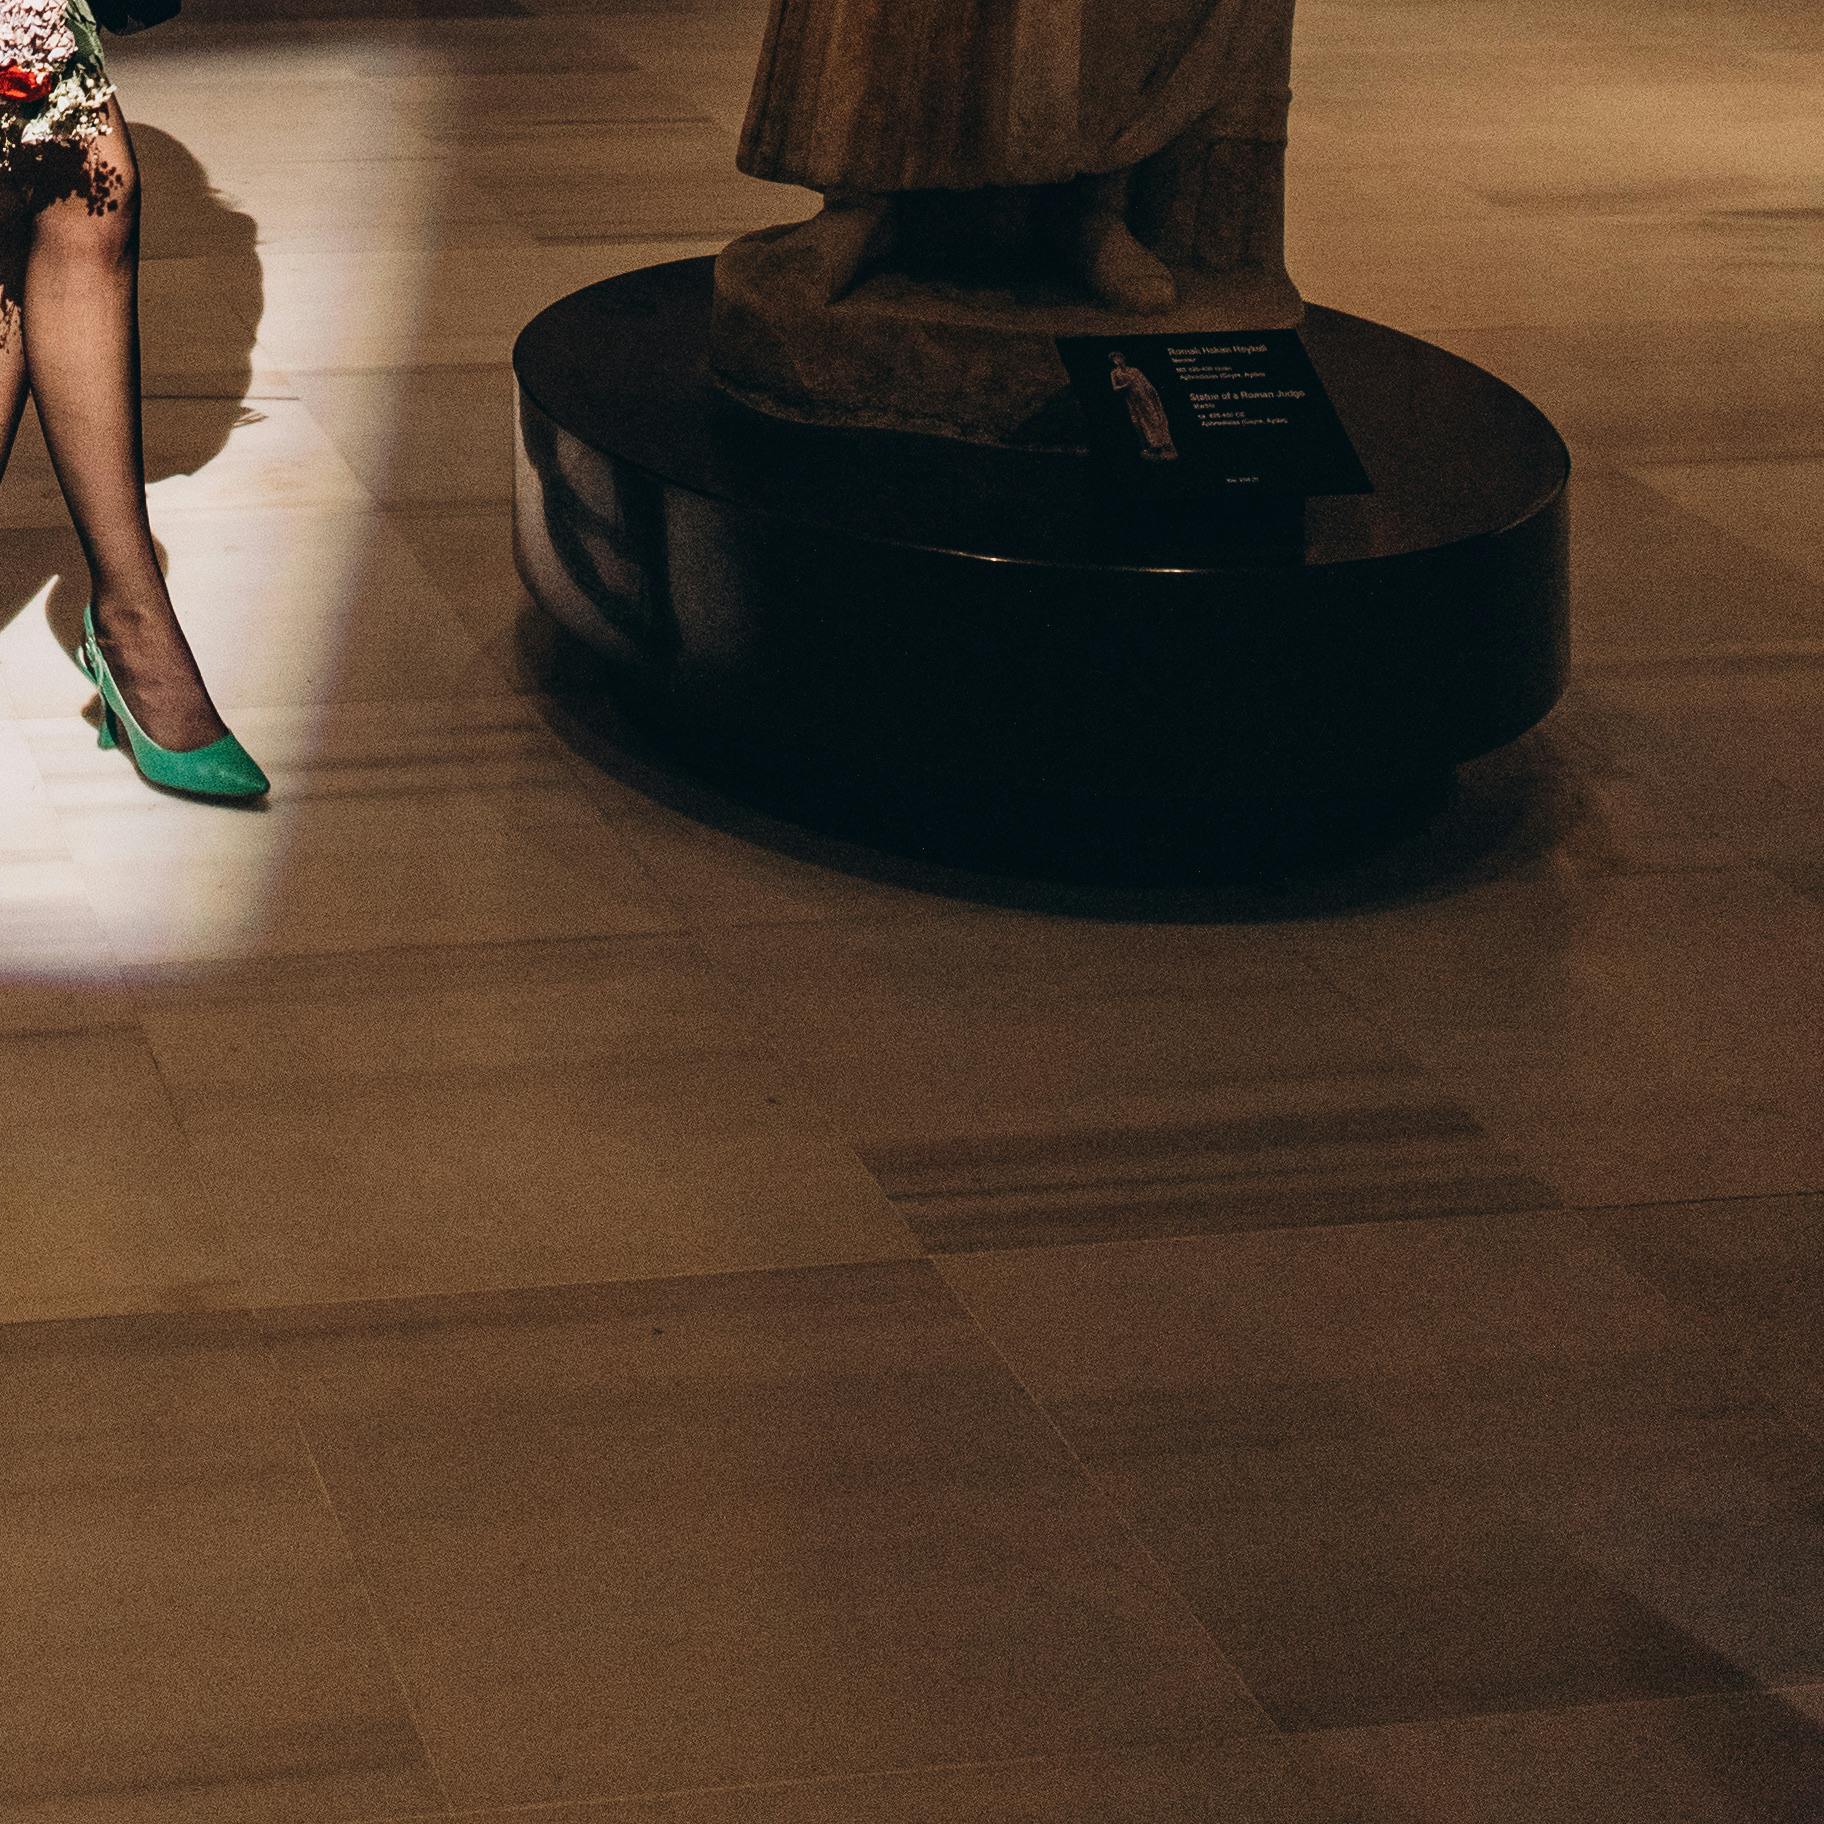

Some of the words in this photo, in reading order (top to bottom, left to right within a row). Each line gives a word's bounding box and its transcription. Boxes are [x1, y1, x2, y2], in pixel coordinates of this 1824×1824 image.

[1189, 393, 1218, 401] Statue
[1221, 392, 1231, 400] of
[1241, 391, 1274, 399] Roman
